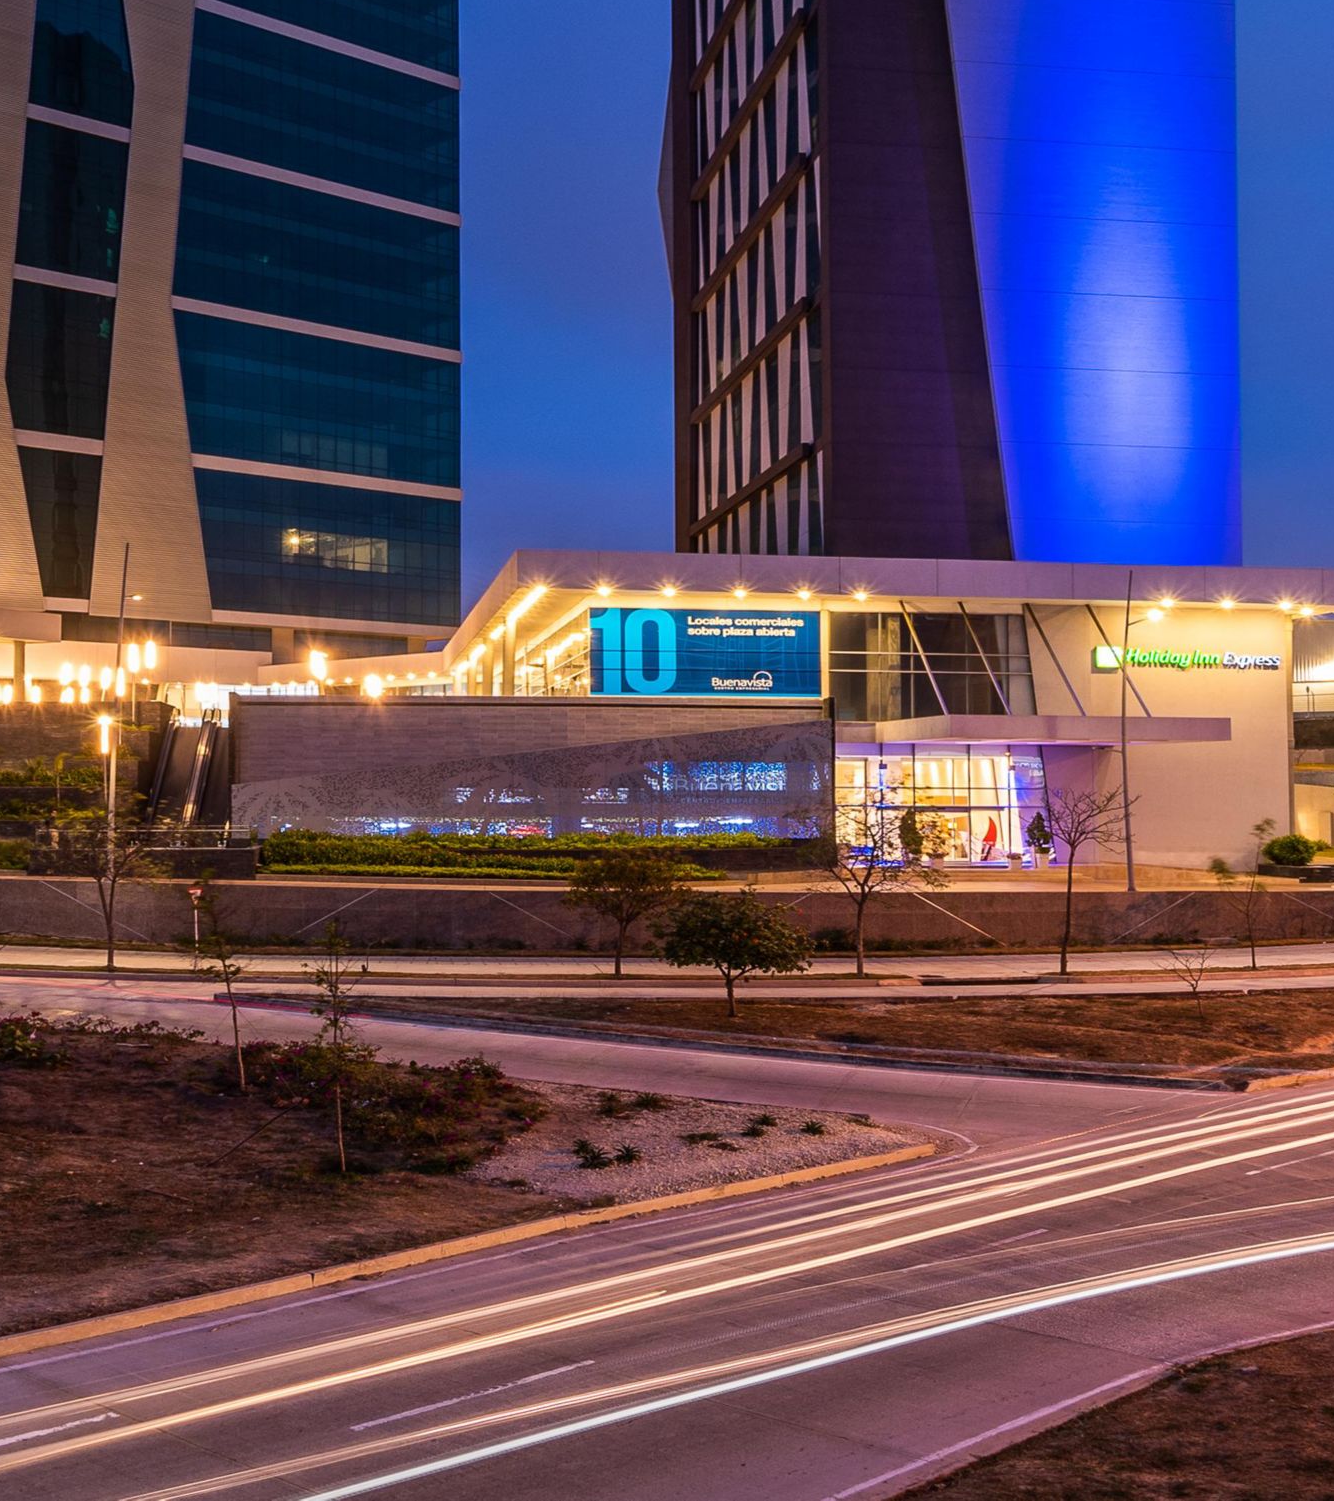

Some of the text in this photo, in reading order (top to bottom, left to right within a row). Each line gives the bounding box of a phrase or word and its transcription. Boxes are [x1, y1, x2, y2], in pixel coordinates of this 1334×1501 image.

[687, 615, 804, 627] Locales comerciales
[687, 626, 796, 638] sobre plaza abierta
[590, 608, 677, 694] 10
[1126, 648, 1281, 668] Holiday Inn Express
[711, 677, 773, 688] Buenavista
